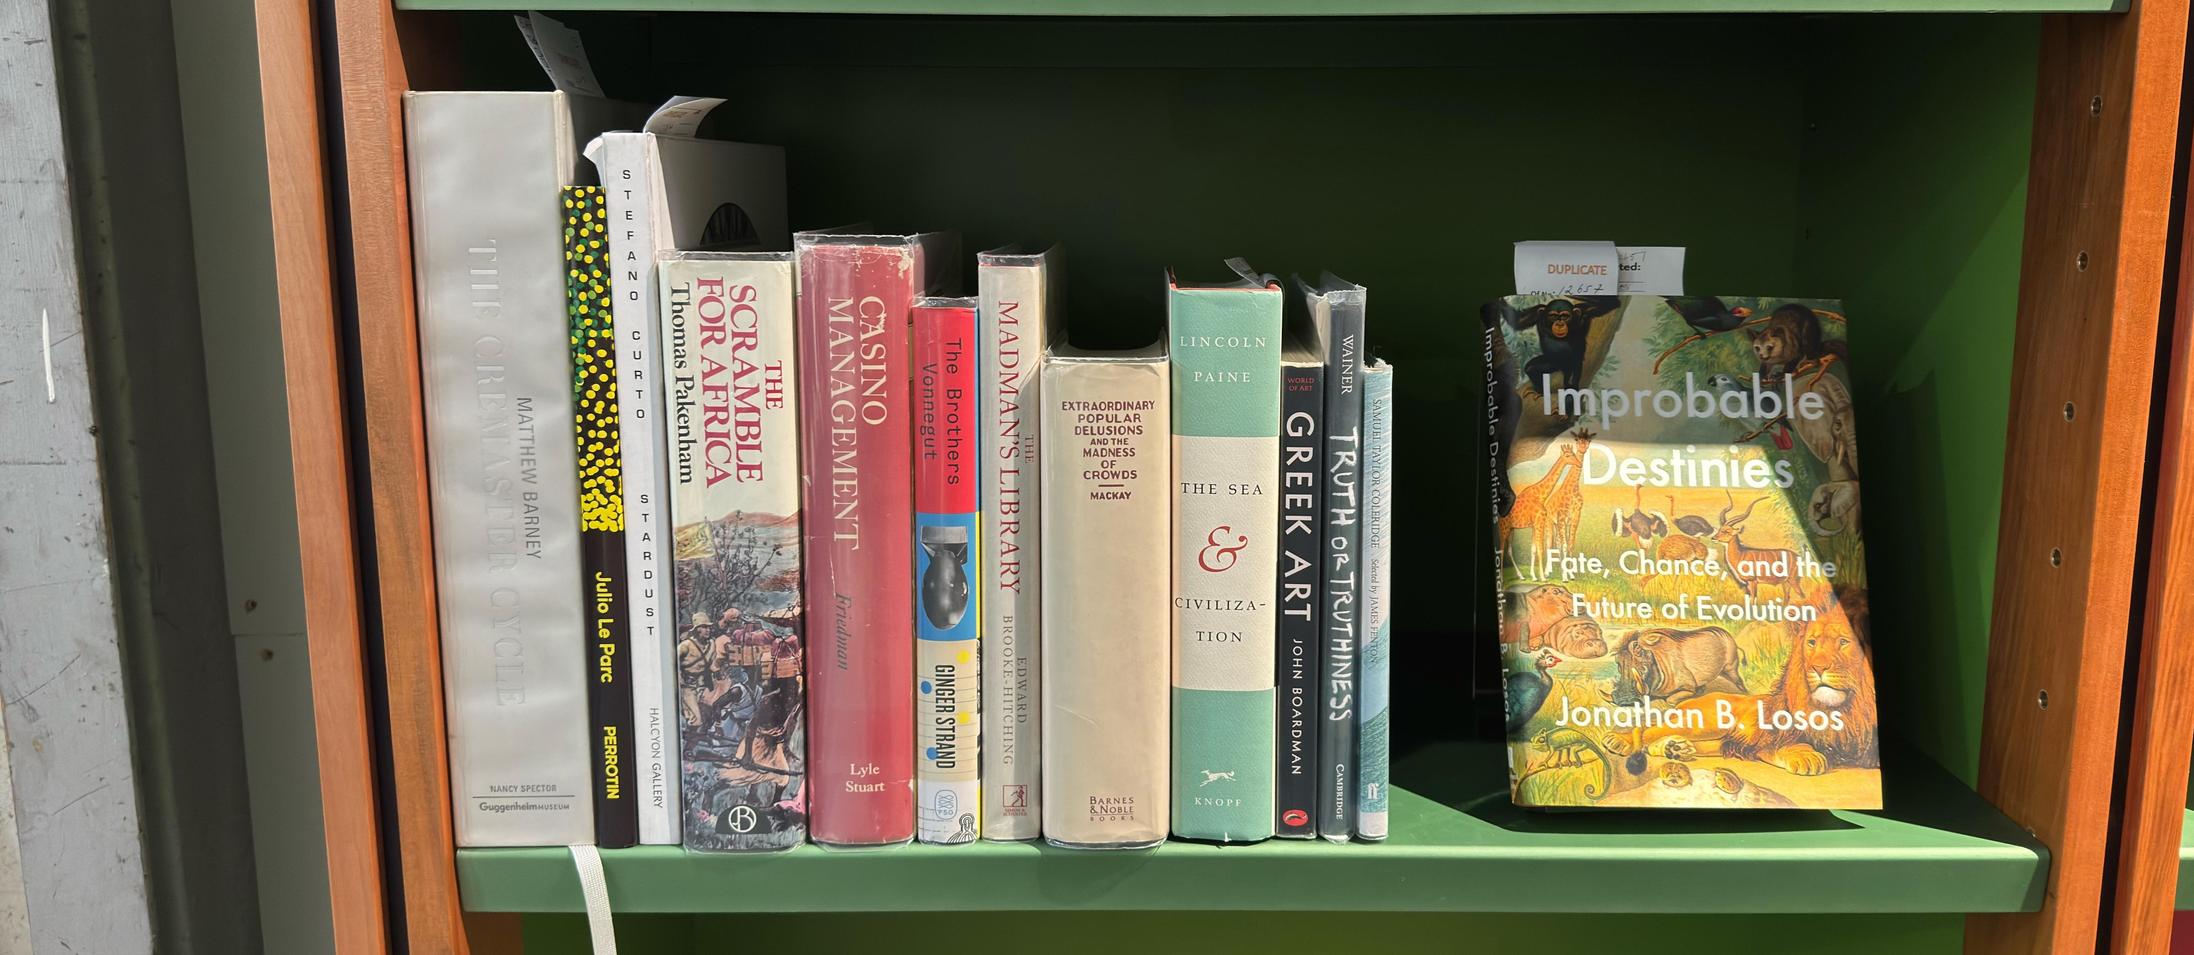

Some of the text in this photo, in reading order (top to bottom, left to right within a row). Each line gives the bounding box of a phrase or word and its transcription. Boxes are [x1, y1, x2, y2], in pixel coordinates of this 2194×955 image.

[622, 169, 645, 419] STEFANO CURTO
[1548, 264, 1607, 276] DUPLICATE
[859, 296, 888, 426] CASINO
[1180, 336, 1267, 348] LINCOLN
[1341, 334, 1354, 395] WAINER
[670, 282, 697, 486] Thomas Pakenham
[697, 276, 732, 489] FOR AFRICA
[729, 285, 763, 483] SCRAMBLE
[764, 360, 784, 410] THE
[1194, 371, 1251, 383] PAINE
[1542, 371, 1825, 430] Improbable
[828, 297, 859, 550] MANAGEMENT
[920, 363, 938, 460] Vonnegut
[945, 338, 963, 485] The Brothers
[1062, 400, 1155, 411] EXTRAORDINARY
[1078, 413, 1142, 423] POPULAR
[1372, 399, 1382, 441] SAMUEL
[1484, 327, 1500, 524] Improbable Destinies
[1024, 434, 1034, 464] THE
[1074, 425, 1143, 436] DELUSIONS
[1083, 447, 1136, 458] MADNESS
[1090, 438, 1129, 446] AND THE
[516, 397, 542, 559] MATTHEW BARNEY
[1083, 470, 1138, 480] CROWDS
[1101, 459, 1117, 469] OF
[1329, 426, 1359, 526] TRUTH
[1372, 445, 1382, 490] TAYLOR
[1583, 444, 1794, 488] Destinies
[1090, 491, 1132, 500] MACKAY
[1180, 482, 1263, 496] THE SEA
[1000, 467, 1020, 594] LIBRARY
[1284, 411, 1315, 622] GREEK ART
[1371, 490, 1381, 549] COLERIDGE
[640, 494, 655, 636] STARDUST
[1198, 525, 1248, 573] &
[1370, 558, 1379, 585] Selected
[1546, 549, 1837, 581] Fate, Chance, and the
[1174, 597, 1267, 611] CIVILIZA-
[1370, 594, 1379, 623] JAMES
[1494, 548, 1506, 635] Jonathan
[1572, 593, 1817, 621] Future of Evolution
[595, 571, 616, 684] Julio Le Parc
[834, 591, 852, 671] Friedman
[1196, 630, 1243, 643] TION
[1329, 571, 1355, 721] TRUTHINESS
[1370, 625, 1379, 664] FENTON
[1002, 615, 1014, 765] BROOKE-HITCHING
[1017, 657, 1027, 724] EDWARD
[1291, 638, 1303, 775] JOHN BOARDMAN
[1555, 696, 1844, 732] Jonathan B. Losos
[935, 664, 955, 769] GINGER STRAND
[603, 725, 620, 800] PERROTIN
[650, 707, 663, 809] HALCYON GALLERY
[850, 763, 880, 777] Lyle
[490, 784, 557, 793] NANCY SPECTOR
[845, 780, 885, 793] Stuart
[1195, 797, 1242, 807] KNOPF
[1335, 763, 1345, 820] CAMBRIDGE
